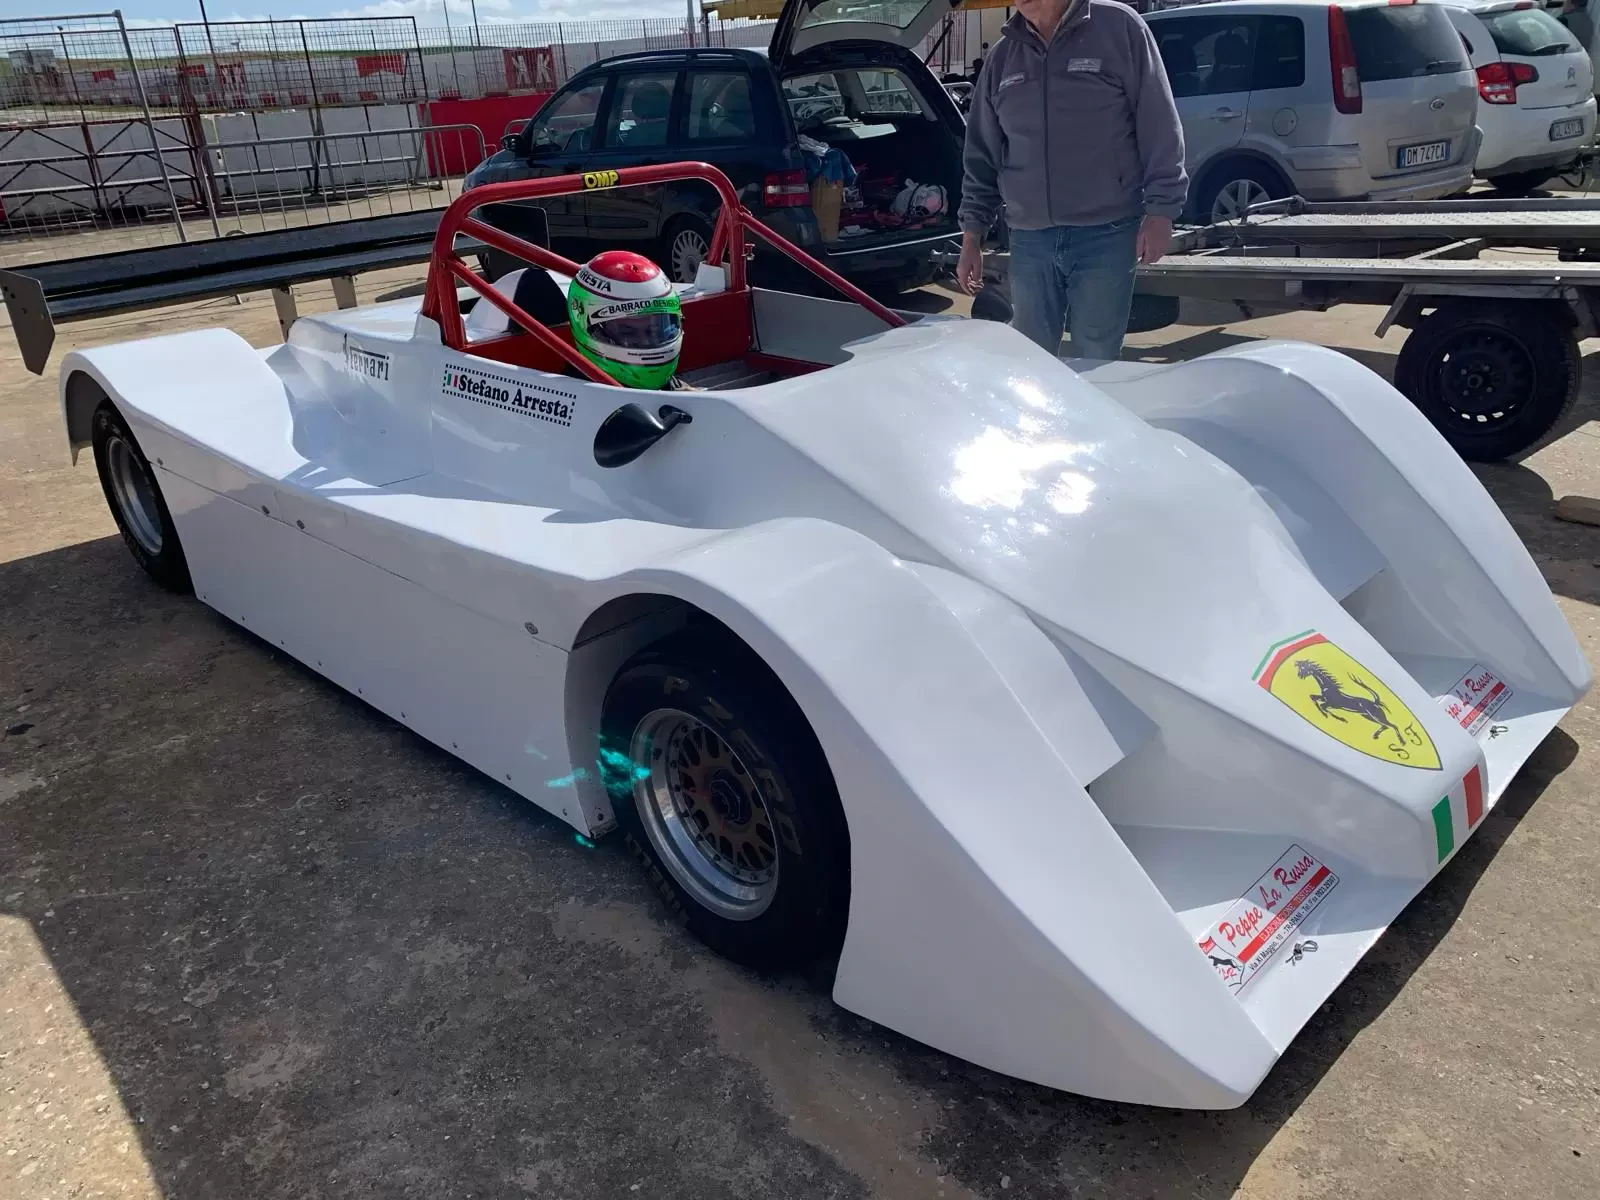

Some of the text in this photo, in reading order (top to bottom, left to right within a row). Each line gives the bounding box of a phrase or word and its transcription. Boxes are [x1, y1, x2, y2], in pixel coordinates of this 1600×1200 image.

[1407, 144, 1445, 164] DM 747CA
[584, 170, 618, 189] OMP
[608, 301, 651, 314] BARRACO
[458, 374, 569, 419] Stefano Arresta
[1218, 855, 1314, 948] Peppe La Russa
[1248, 960, 1258, 971] Via
[1283, 911, 1303, 932] TRAPANI
